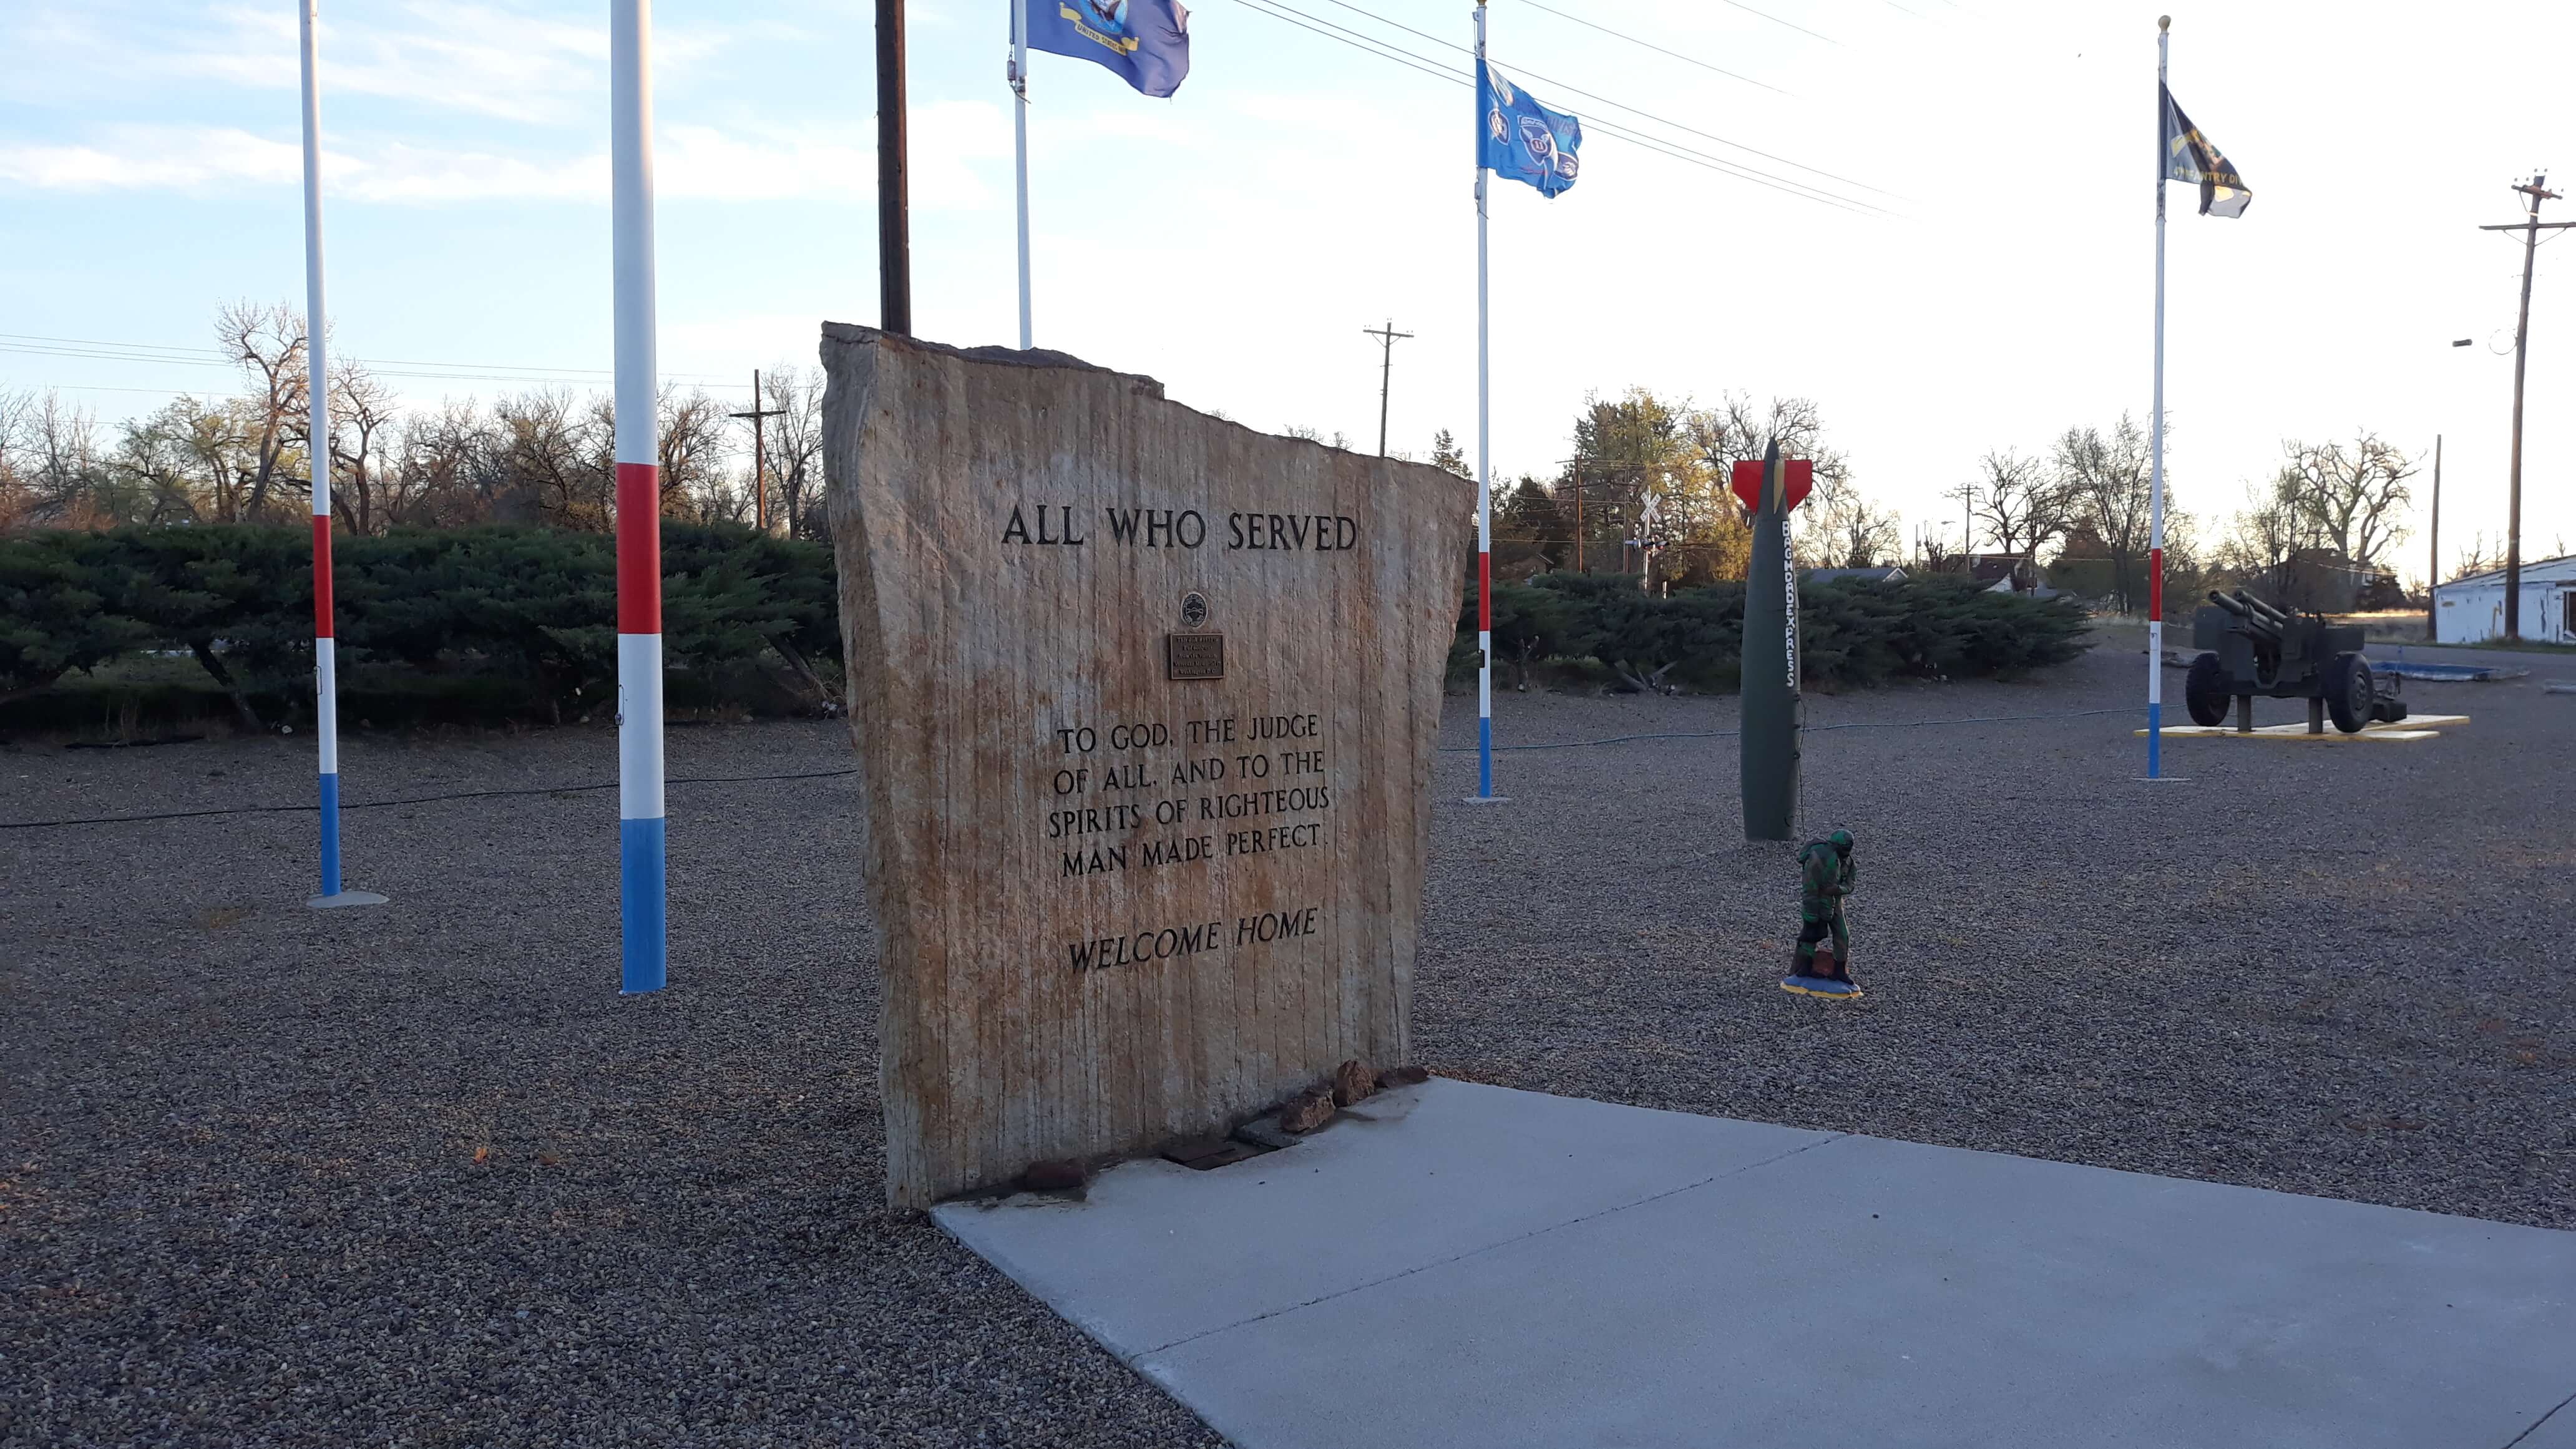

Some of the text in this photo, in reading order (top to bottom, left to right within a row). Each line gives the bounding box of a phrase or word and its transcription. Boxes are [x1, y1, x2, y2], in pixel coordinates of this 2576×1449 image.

[1001, 504, 1357, 550] ALL WHO SERVED
[1056, 727, 1096, 754] TO
[1188, 719, 1235, 744] THE
[1247, 715, 1318, 741] JUDGE
[1054, 769, 1089, 794] OF
[1171, 758, 1225, 784] AND
[1237, 754, 1269, 779] TO
[1280, 751, 1324, 775] THE
[1050, 786, 1329, 838] SPIRITS OF RIGHTEOUS
[1063, 846, 1126, 877] MAN
[1142, 836, 1213, 867] MADE
[1068, 907, 1318, 974] WELCOME HOME
